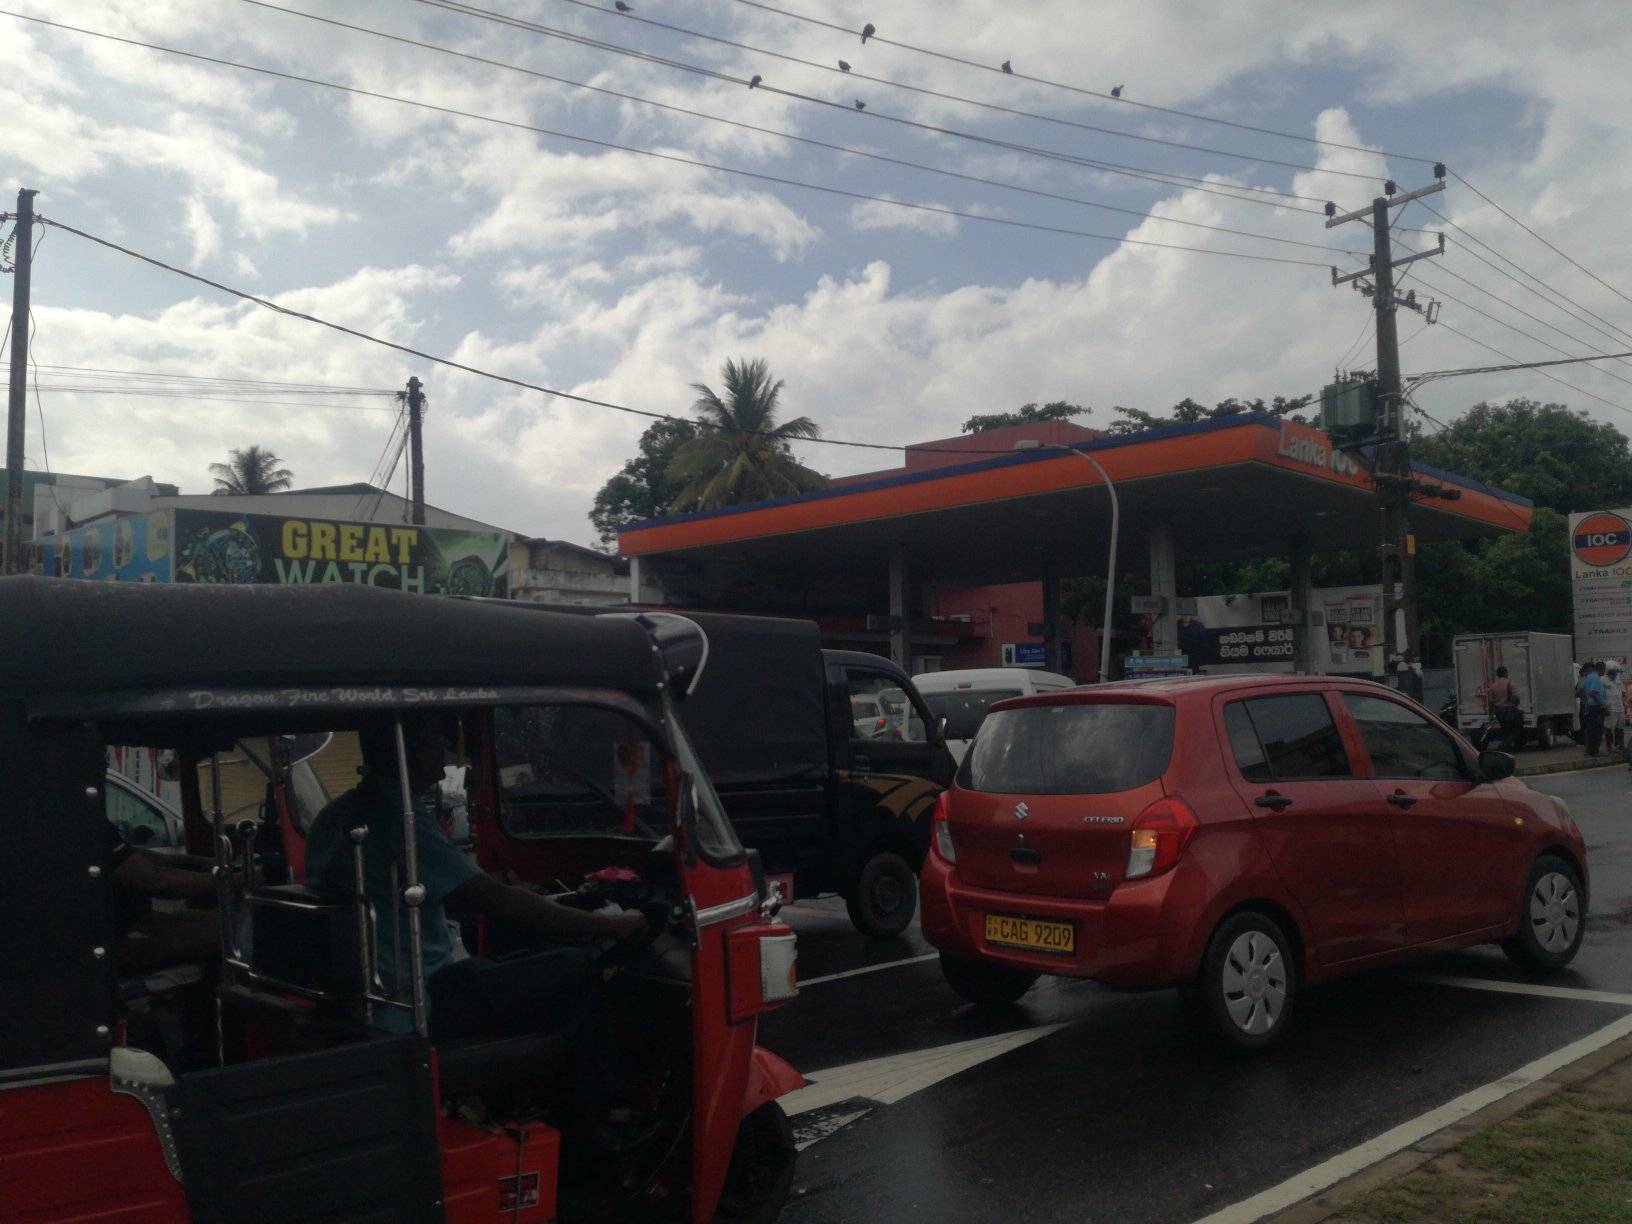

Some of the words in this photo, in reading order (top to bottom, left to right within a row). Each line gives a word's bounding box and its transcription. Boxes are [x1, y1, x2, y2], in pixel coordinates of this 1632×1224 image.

[1278, 425, 1326, 467] Lanka
[282, 520, 417, 564] GREAT
[1587, 533, 1617, 546] IOC
[274, 558, 425, 595] WATCH
[1575, 568, 1609, 579] Lanka
[189, 691, 279, 710] Dragon
[281, 689, 330, 707] Fire
[331, 688, 396, 702] World
[403, 688, 438, 702] Sri
[443, 688, 501, 700] Lanka
[1084, 815, 1125, 824] CELERIO
[1000, 919, 1029, 943] CAG
[1034, 923, 1072, 948] 9209
